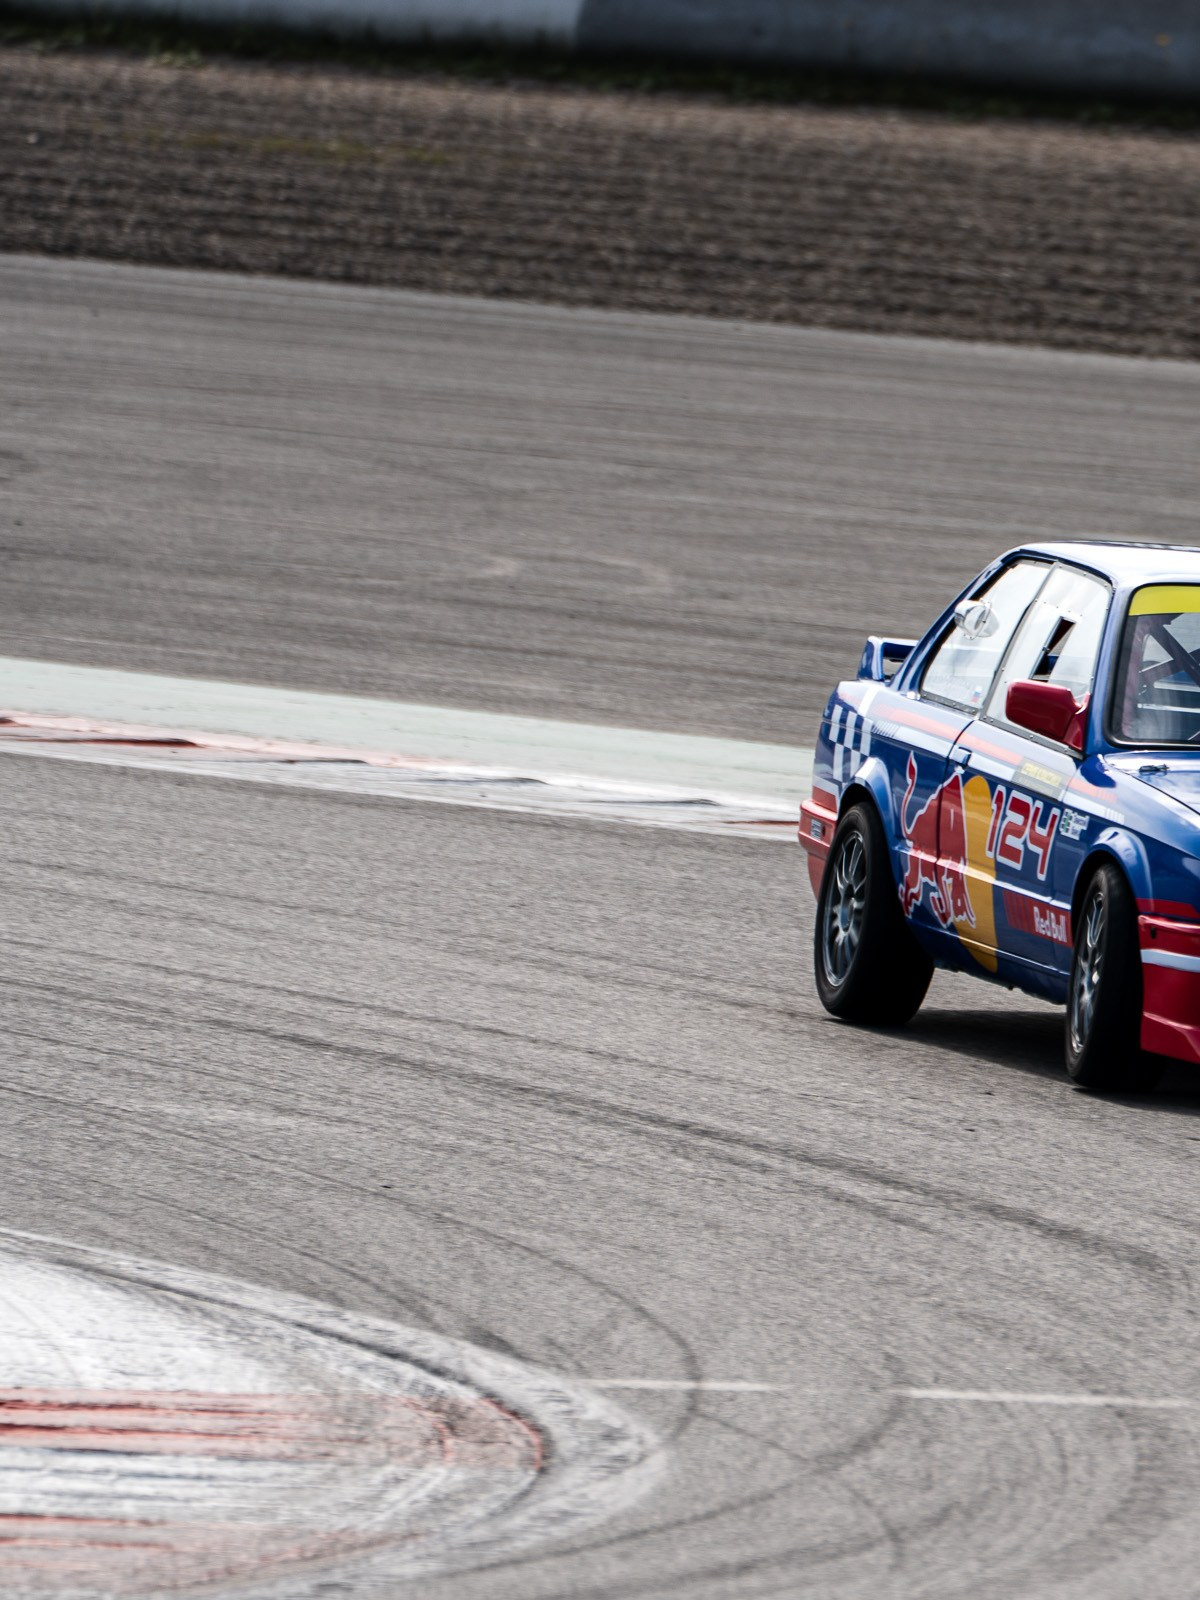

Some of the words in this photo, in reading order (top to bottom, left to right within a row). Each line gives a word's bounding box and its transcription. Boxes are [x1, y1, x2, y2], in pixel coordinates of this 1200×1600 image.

[986, 785, 1060, 882] 124
[1033, 906, 1051, 937] Red
[1050, 912, 1068, 943] Bull
